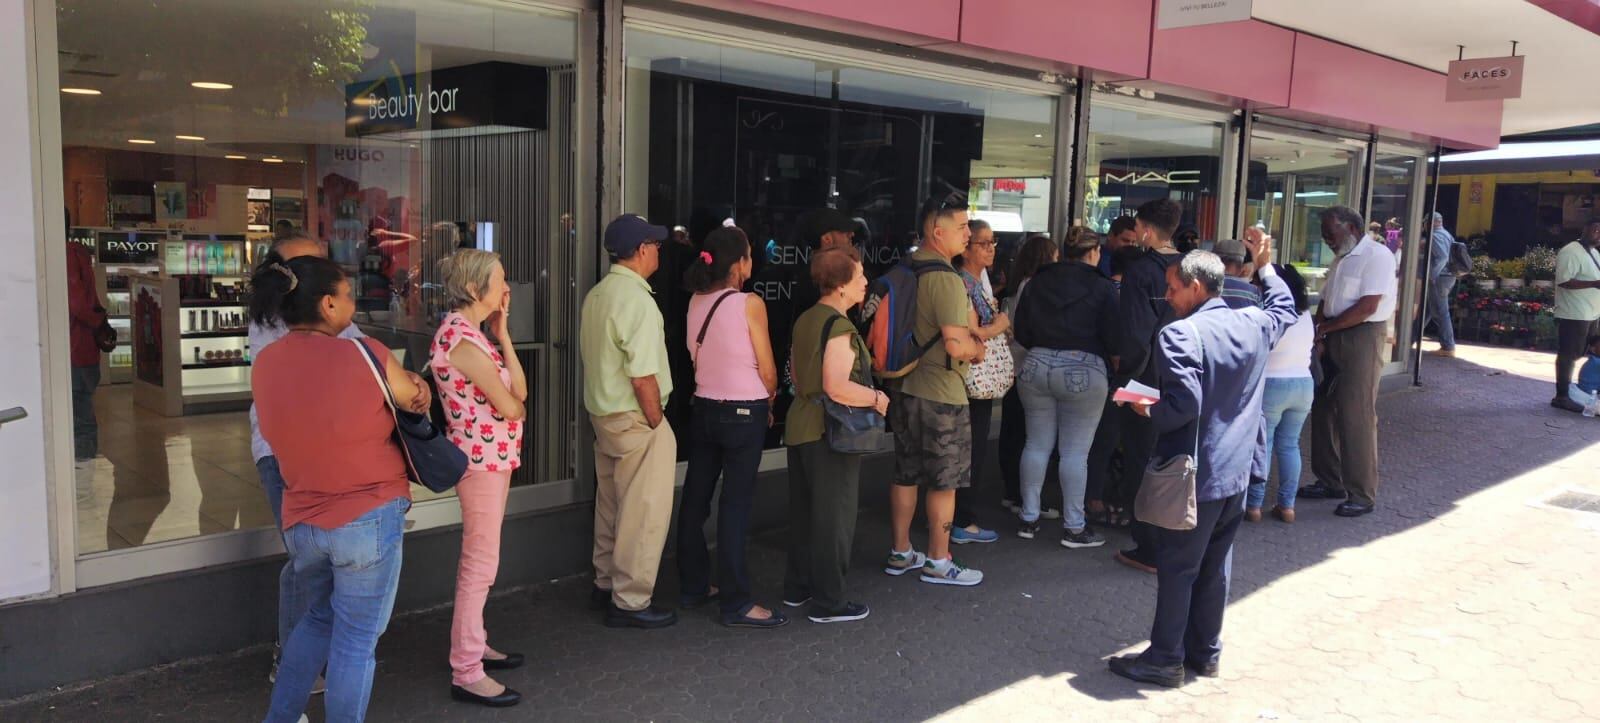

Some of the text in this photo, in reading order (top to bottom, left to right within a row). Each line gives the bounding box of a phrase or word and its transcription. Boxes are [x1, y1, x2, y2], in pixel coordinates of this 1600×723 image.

[1463, 69, 1507, 80] FACES
[369, 83, 459, 122] Beauty bar
[334, 148, 385, 162] HUGO
[107, 241, 160, 251] PAYOT
